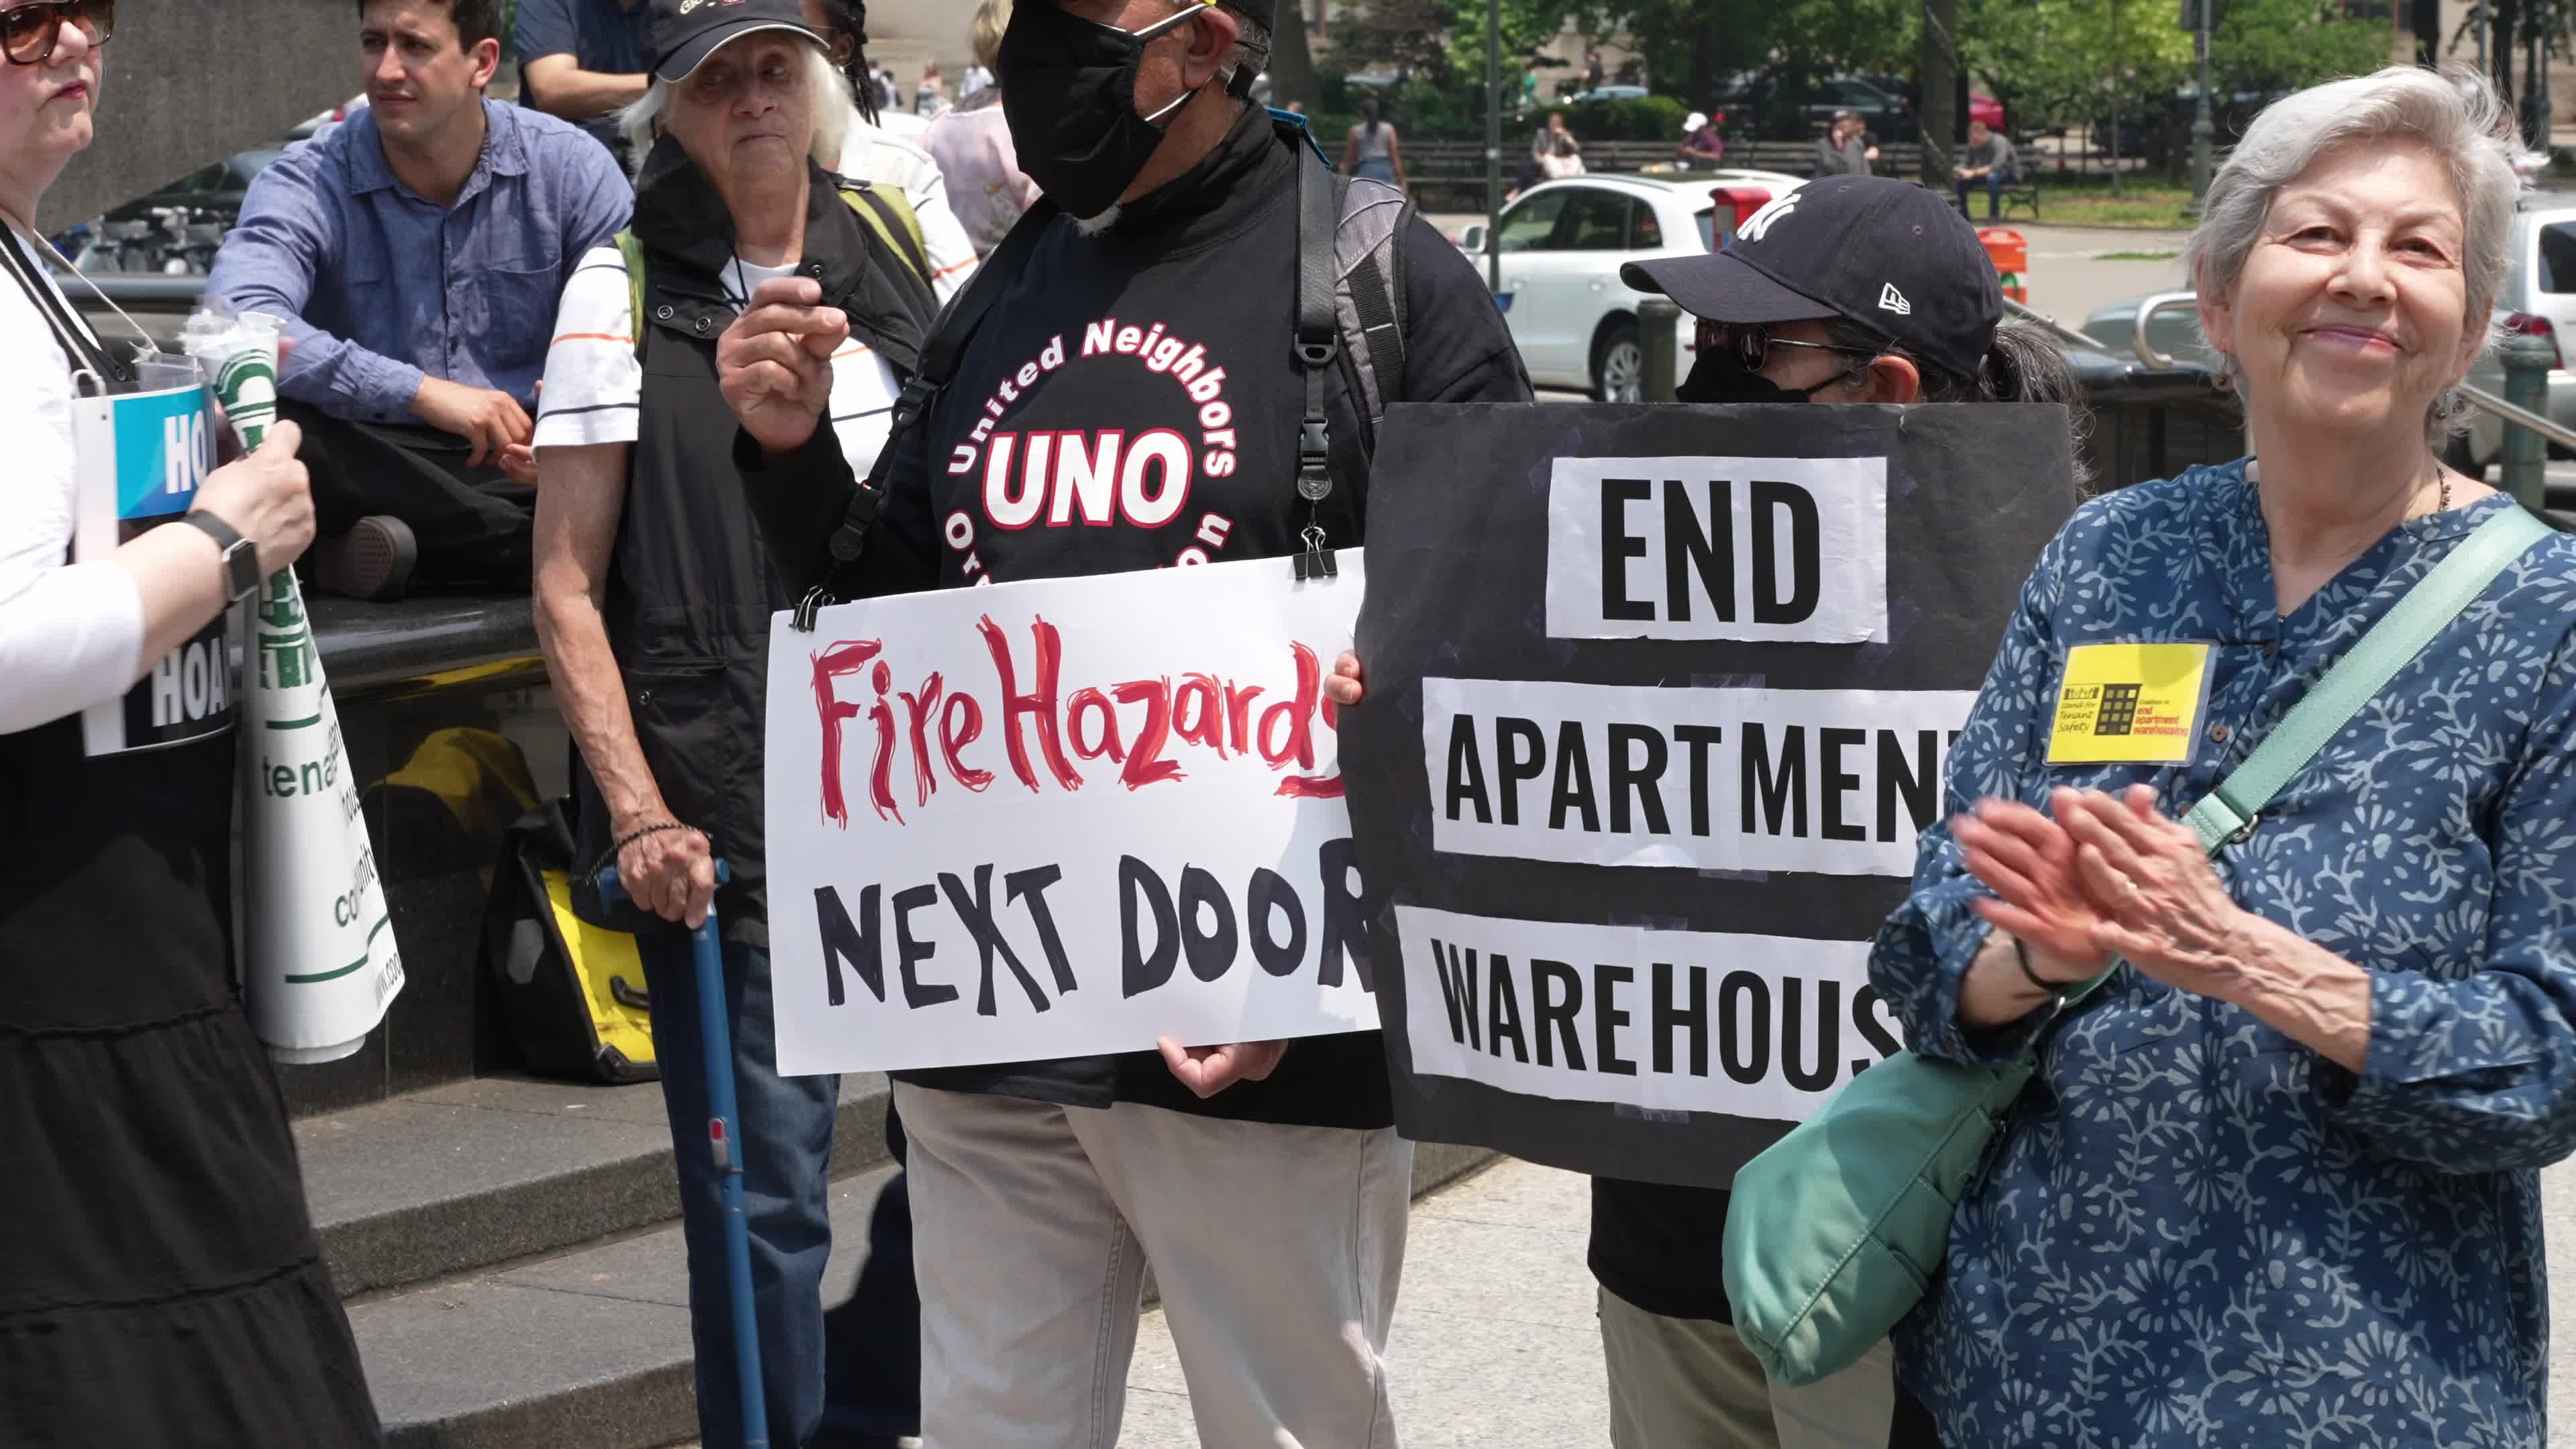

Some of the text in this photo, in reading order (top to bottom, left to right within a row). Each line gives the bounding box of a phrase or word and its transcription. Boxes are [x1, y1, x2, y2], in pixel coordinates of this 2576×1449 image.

[947, 317, 1238, 478] United Neighbors
[981, 427, 1193, 530] UNO
[1601, 478, 1821, 625] END
[810, 638, 995, 830] Fire
[1445, 712, 1963, 843] APARTMEN
[2135, 716, 2180, 725] apartment
[814, 837, 1375, 1016] NEXT DOOR
[1430, 938, 1902, 1092] WAREHOUS
